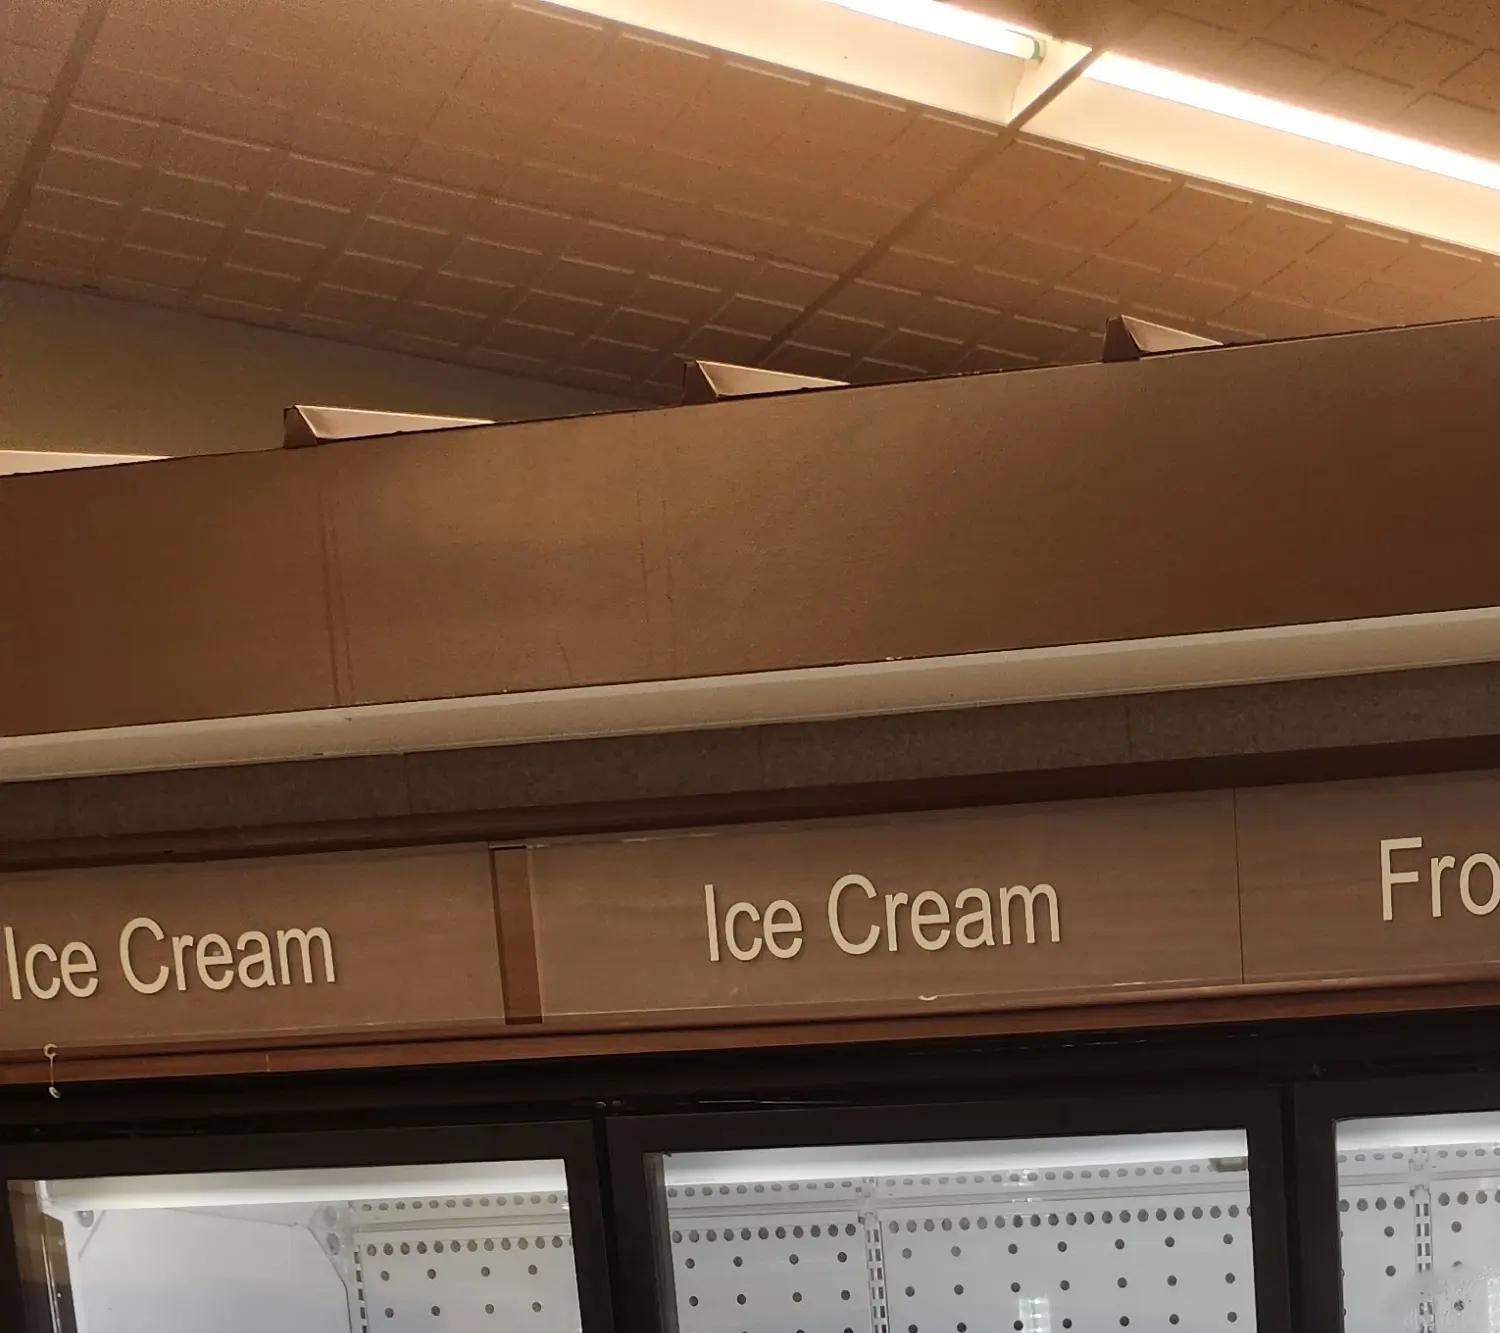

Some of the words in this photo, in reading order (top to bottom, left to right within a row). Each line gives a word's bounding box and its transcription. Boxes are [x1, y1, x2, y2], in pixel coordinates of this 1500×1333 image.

[3, 926, 99, 1000] Ice
[118, 916, 337, 995] Cream
[704, 883, 804, 962] Ice
[827, 873, 1061, 955] Cream
